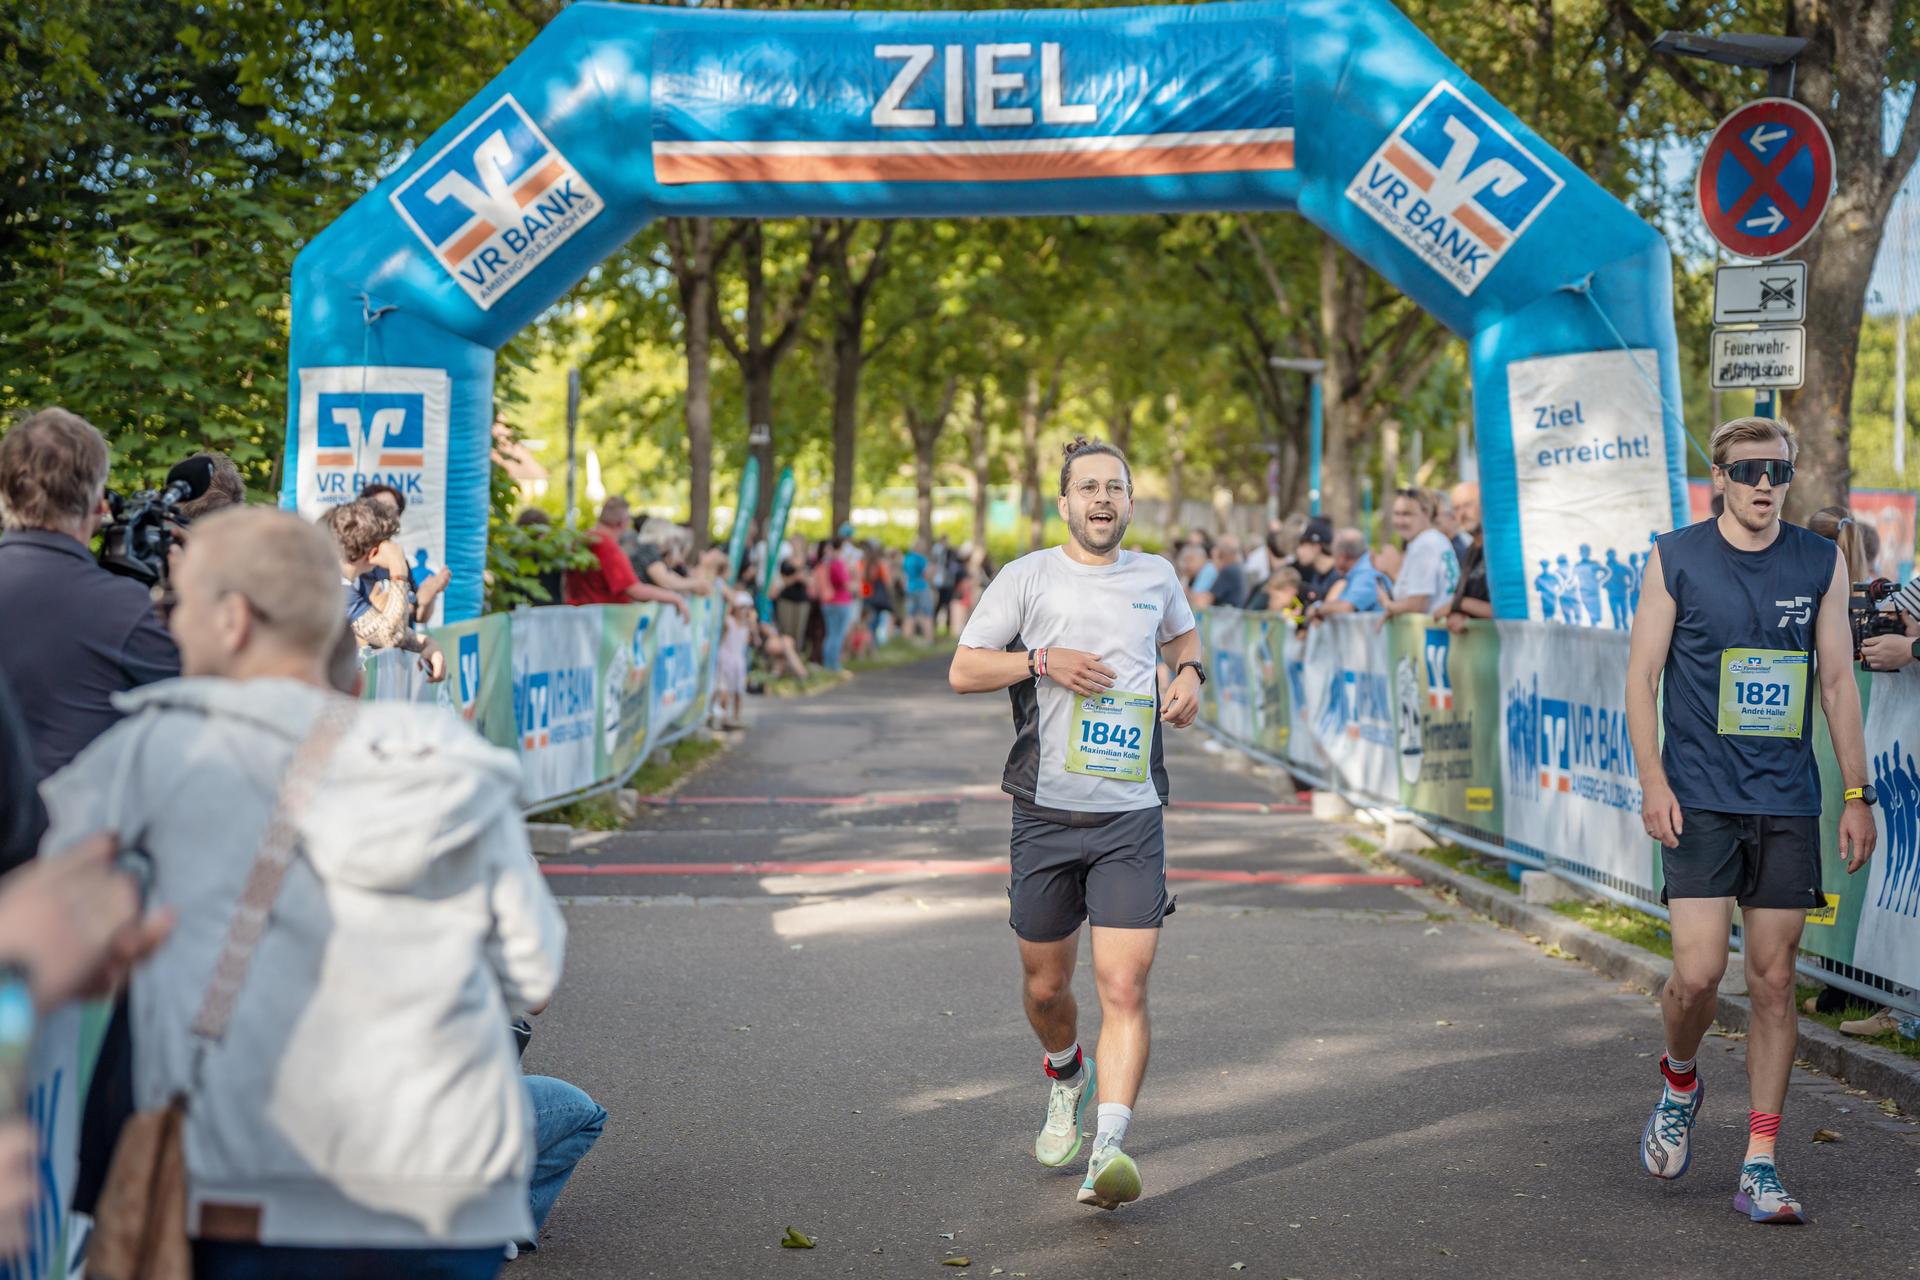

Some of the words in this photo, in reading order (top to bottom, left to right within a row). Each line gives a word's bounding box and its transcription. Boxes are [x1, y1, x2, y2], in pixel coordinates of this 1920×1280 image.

[871, 42, 1097, 126] ZIEL
[460, 246, 508, 286] VR
[502, 180, 586, 254] BANK
[1367, 163, 1409, 209] VR
[1405, 198, 1490, 275] BANK
[1724, 338, 1790, 357] Feuerwehr-
[1534, 402, 1584, 430] Ziel
[1537, 435, 1650, 467] erreicht!
[316, 473, 345, 493] VR
[1735, 682, 1790, 706] 1821
[1741, 706, 1765, 715] André
[1766, 708, 1786, 717] Haller
[1082, 719, 1141, 750] 1842
[1571, 702, 1596, 767] VR
[1598, 707, 1638, 780] BAN
[1080, 745, 1122, 758] Maximilian
